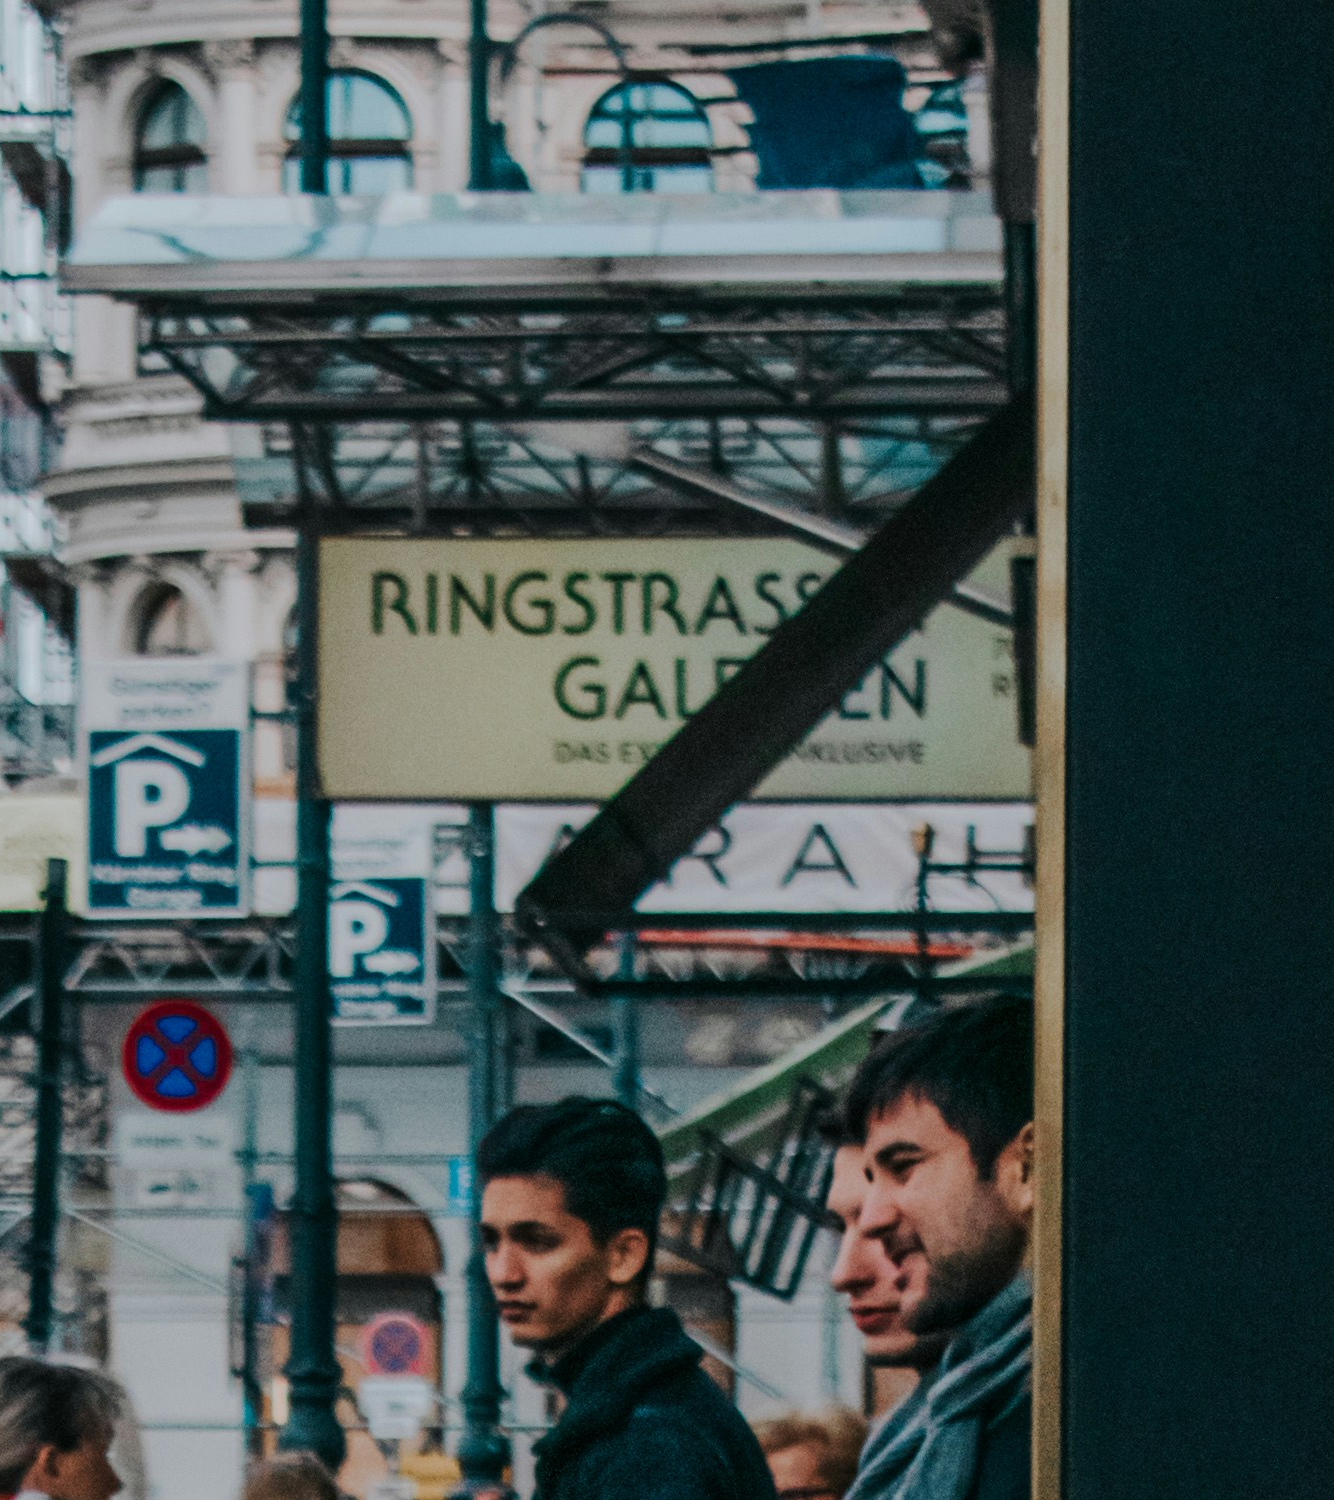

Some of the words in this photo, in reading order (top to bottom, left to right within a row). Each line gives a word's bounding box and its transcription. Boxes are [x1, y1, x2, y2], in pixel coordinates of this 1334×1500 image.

[370, 570, 924, 637] RINGSTRASS
[553, 655, 926, 722] GALEN
[114, 760, 191, 858] P
[328, 899, 388, 978] P
